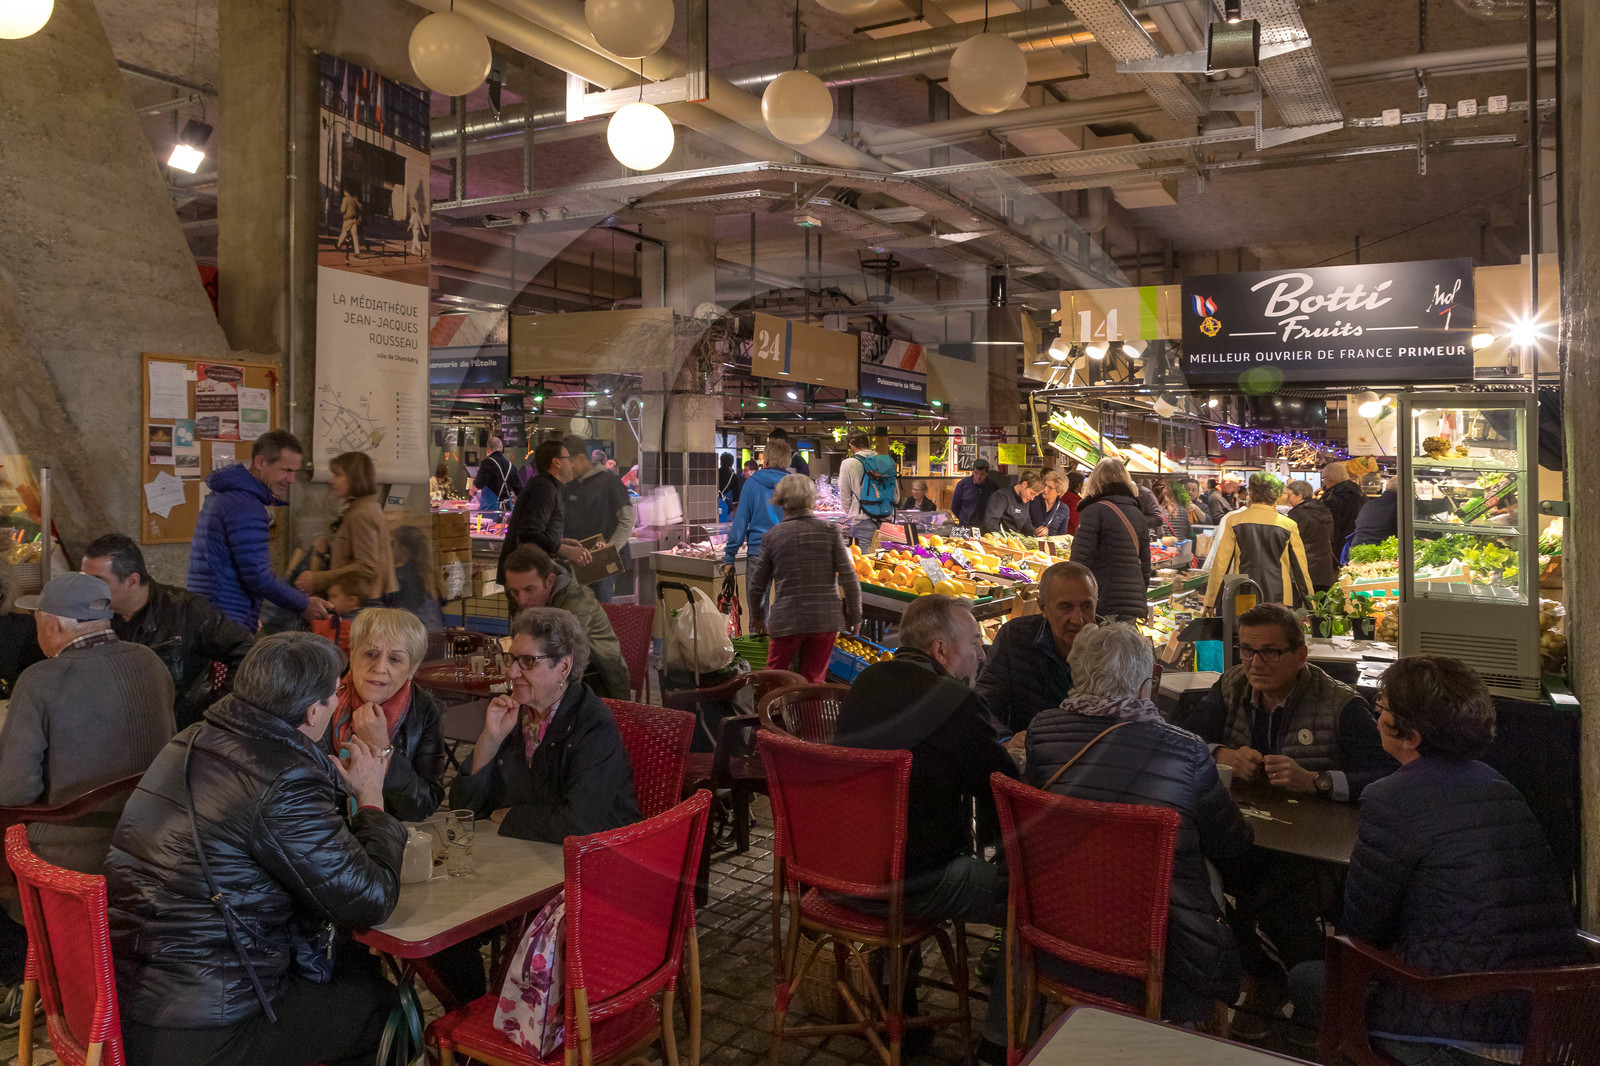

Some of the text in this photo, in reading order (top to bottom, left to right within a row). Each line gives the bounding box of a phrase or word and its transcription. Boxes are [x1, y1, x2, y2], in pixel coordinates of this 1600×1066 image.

[333, 293, 419, 318] LA MÉDIATHÈQUE
[1251, 273, 1393, 318] Botti
[343, 312, 419, 334] JEAN-JACQUES
[1078, 308, 1122, 342] 14
[1278, 315, 1363, 342] Fruits
[369, 333, 418, 350] ROUSSEAU
[758, 329, 780, 361] 24
[1189, 345, 1467, 364] MEILLEUR OUVRIER DE FRANCE PRIMEUR
